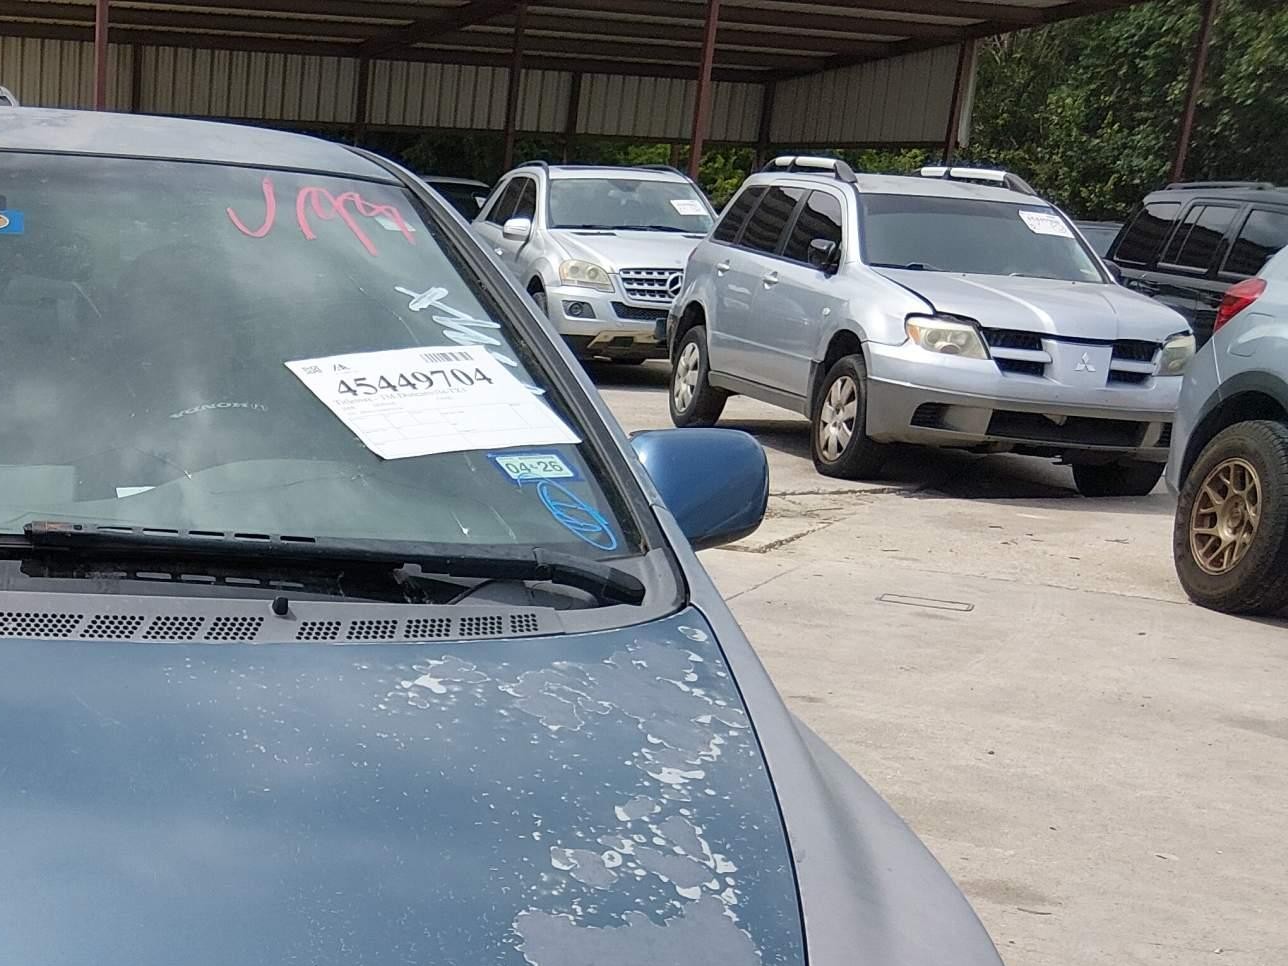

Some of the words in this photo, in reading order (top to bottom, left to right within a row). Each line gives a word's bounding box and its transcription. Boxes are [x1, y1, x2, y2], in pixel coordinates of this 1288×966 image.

[337, 367, 495, 397] 45449704
[504, 461, 532, 474] 04
[537, 460, 564, 473] 26
